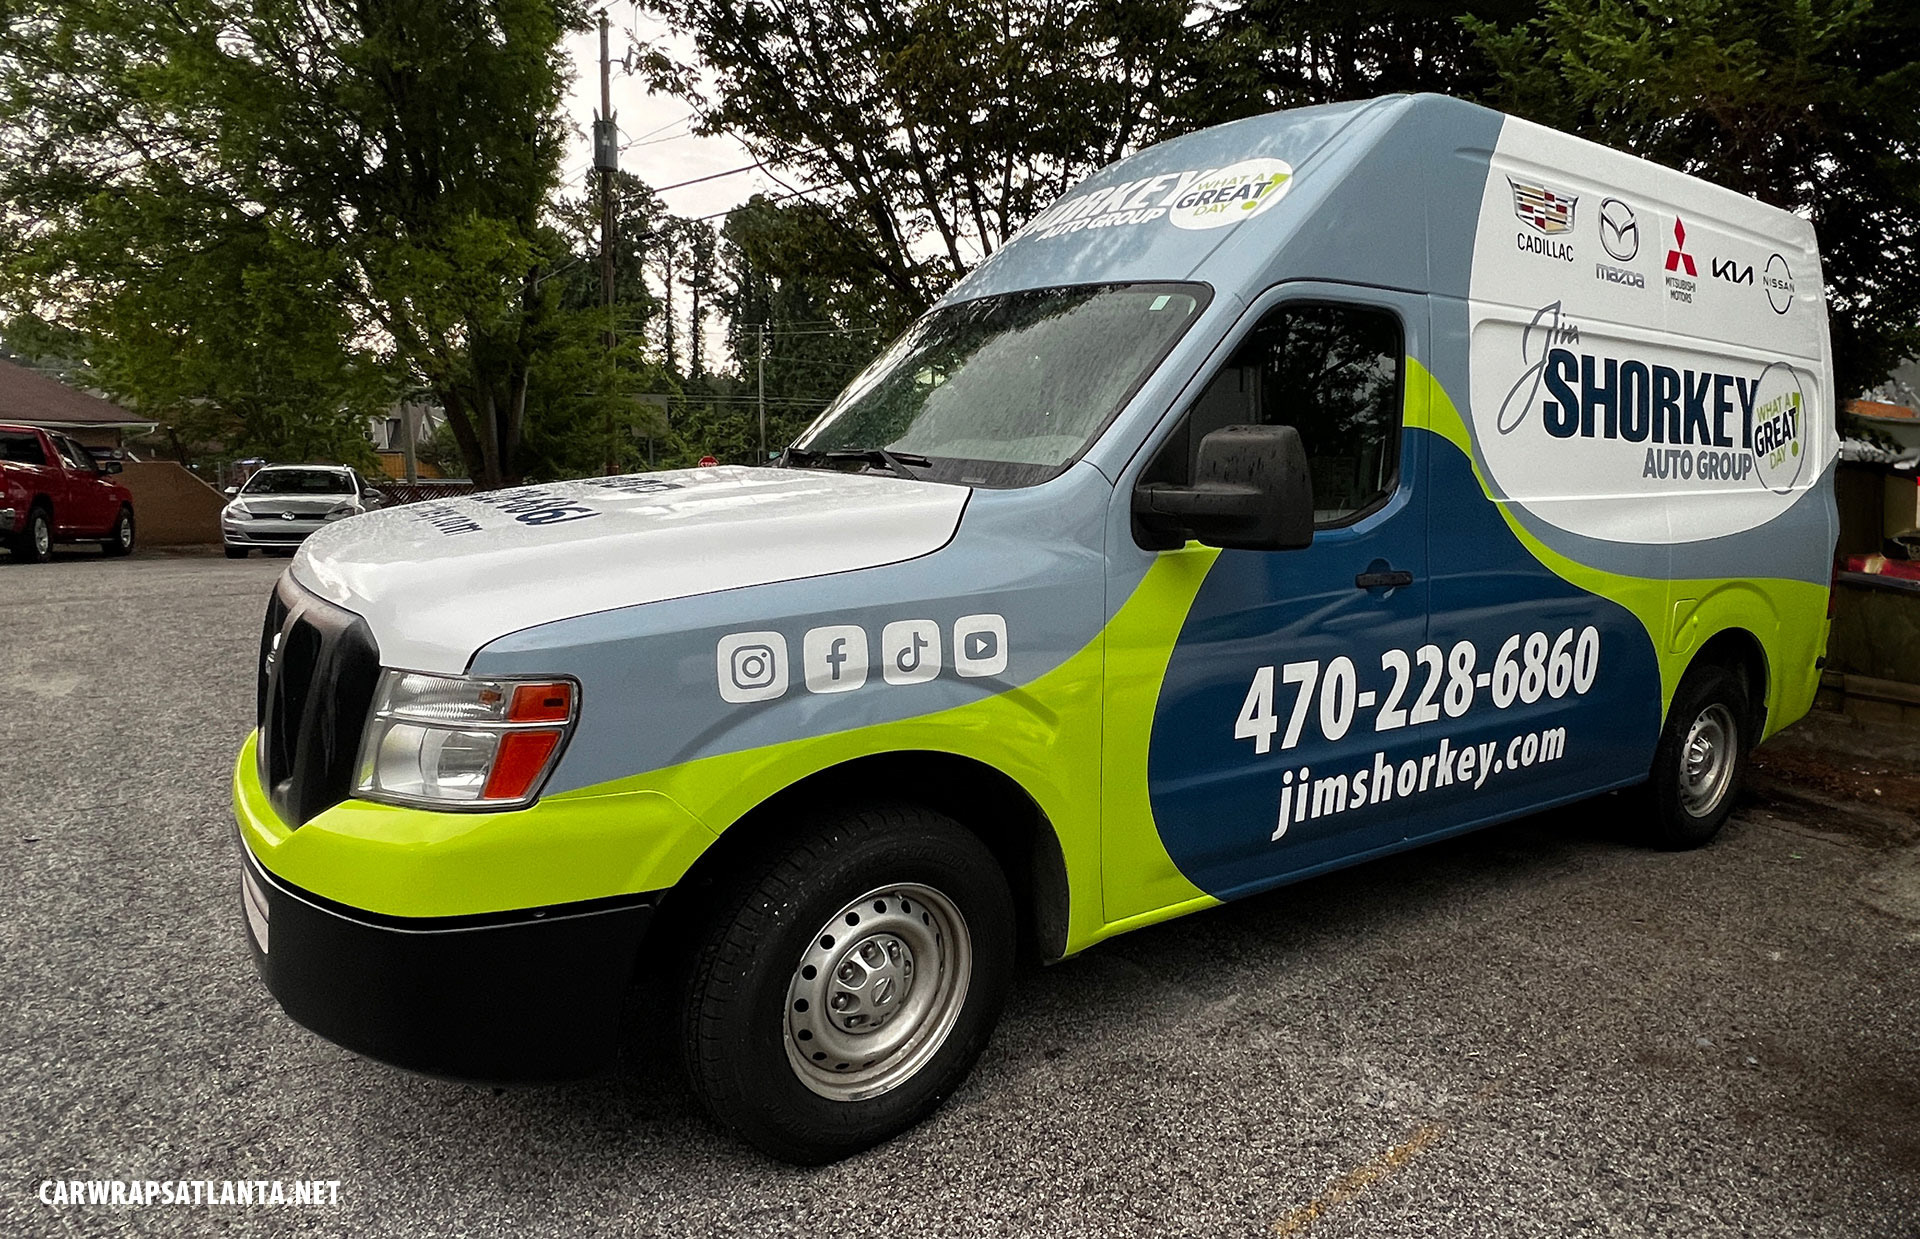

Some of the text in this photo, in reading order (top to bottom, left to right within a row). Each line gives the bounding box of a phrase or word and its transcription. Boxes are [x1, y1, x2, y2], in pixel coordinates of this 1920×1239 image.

[1197, 172, 1266, 191] WHAT A
[1006, 167, 1218, 244] HORKEY
[1034, 207, 1168, 243] AUTO GROUP
[1516, 232, 1574, 263] CADILLAC
[1596, 263, 1645, 289] mazda
[1665, 276, 1696, 292] MITSUBISHI
[1711, 256, 1754, 286] KIA
[1762, 276, 1795, 293] NISSAN
[1670, 289, 1692, 304] MOTORS
[1497, 299, 1580, 435] Jim
[1542, 348, 1760, 449] SHORKEY
[1757, 392, 1792, 422] WHAT A
[1642, 447, 1752, 481] AUTO GROUP
[1234, 625, 1600, 755] 470-228-6860
[1271, 726, 1566, 842] jimshorkey.com
